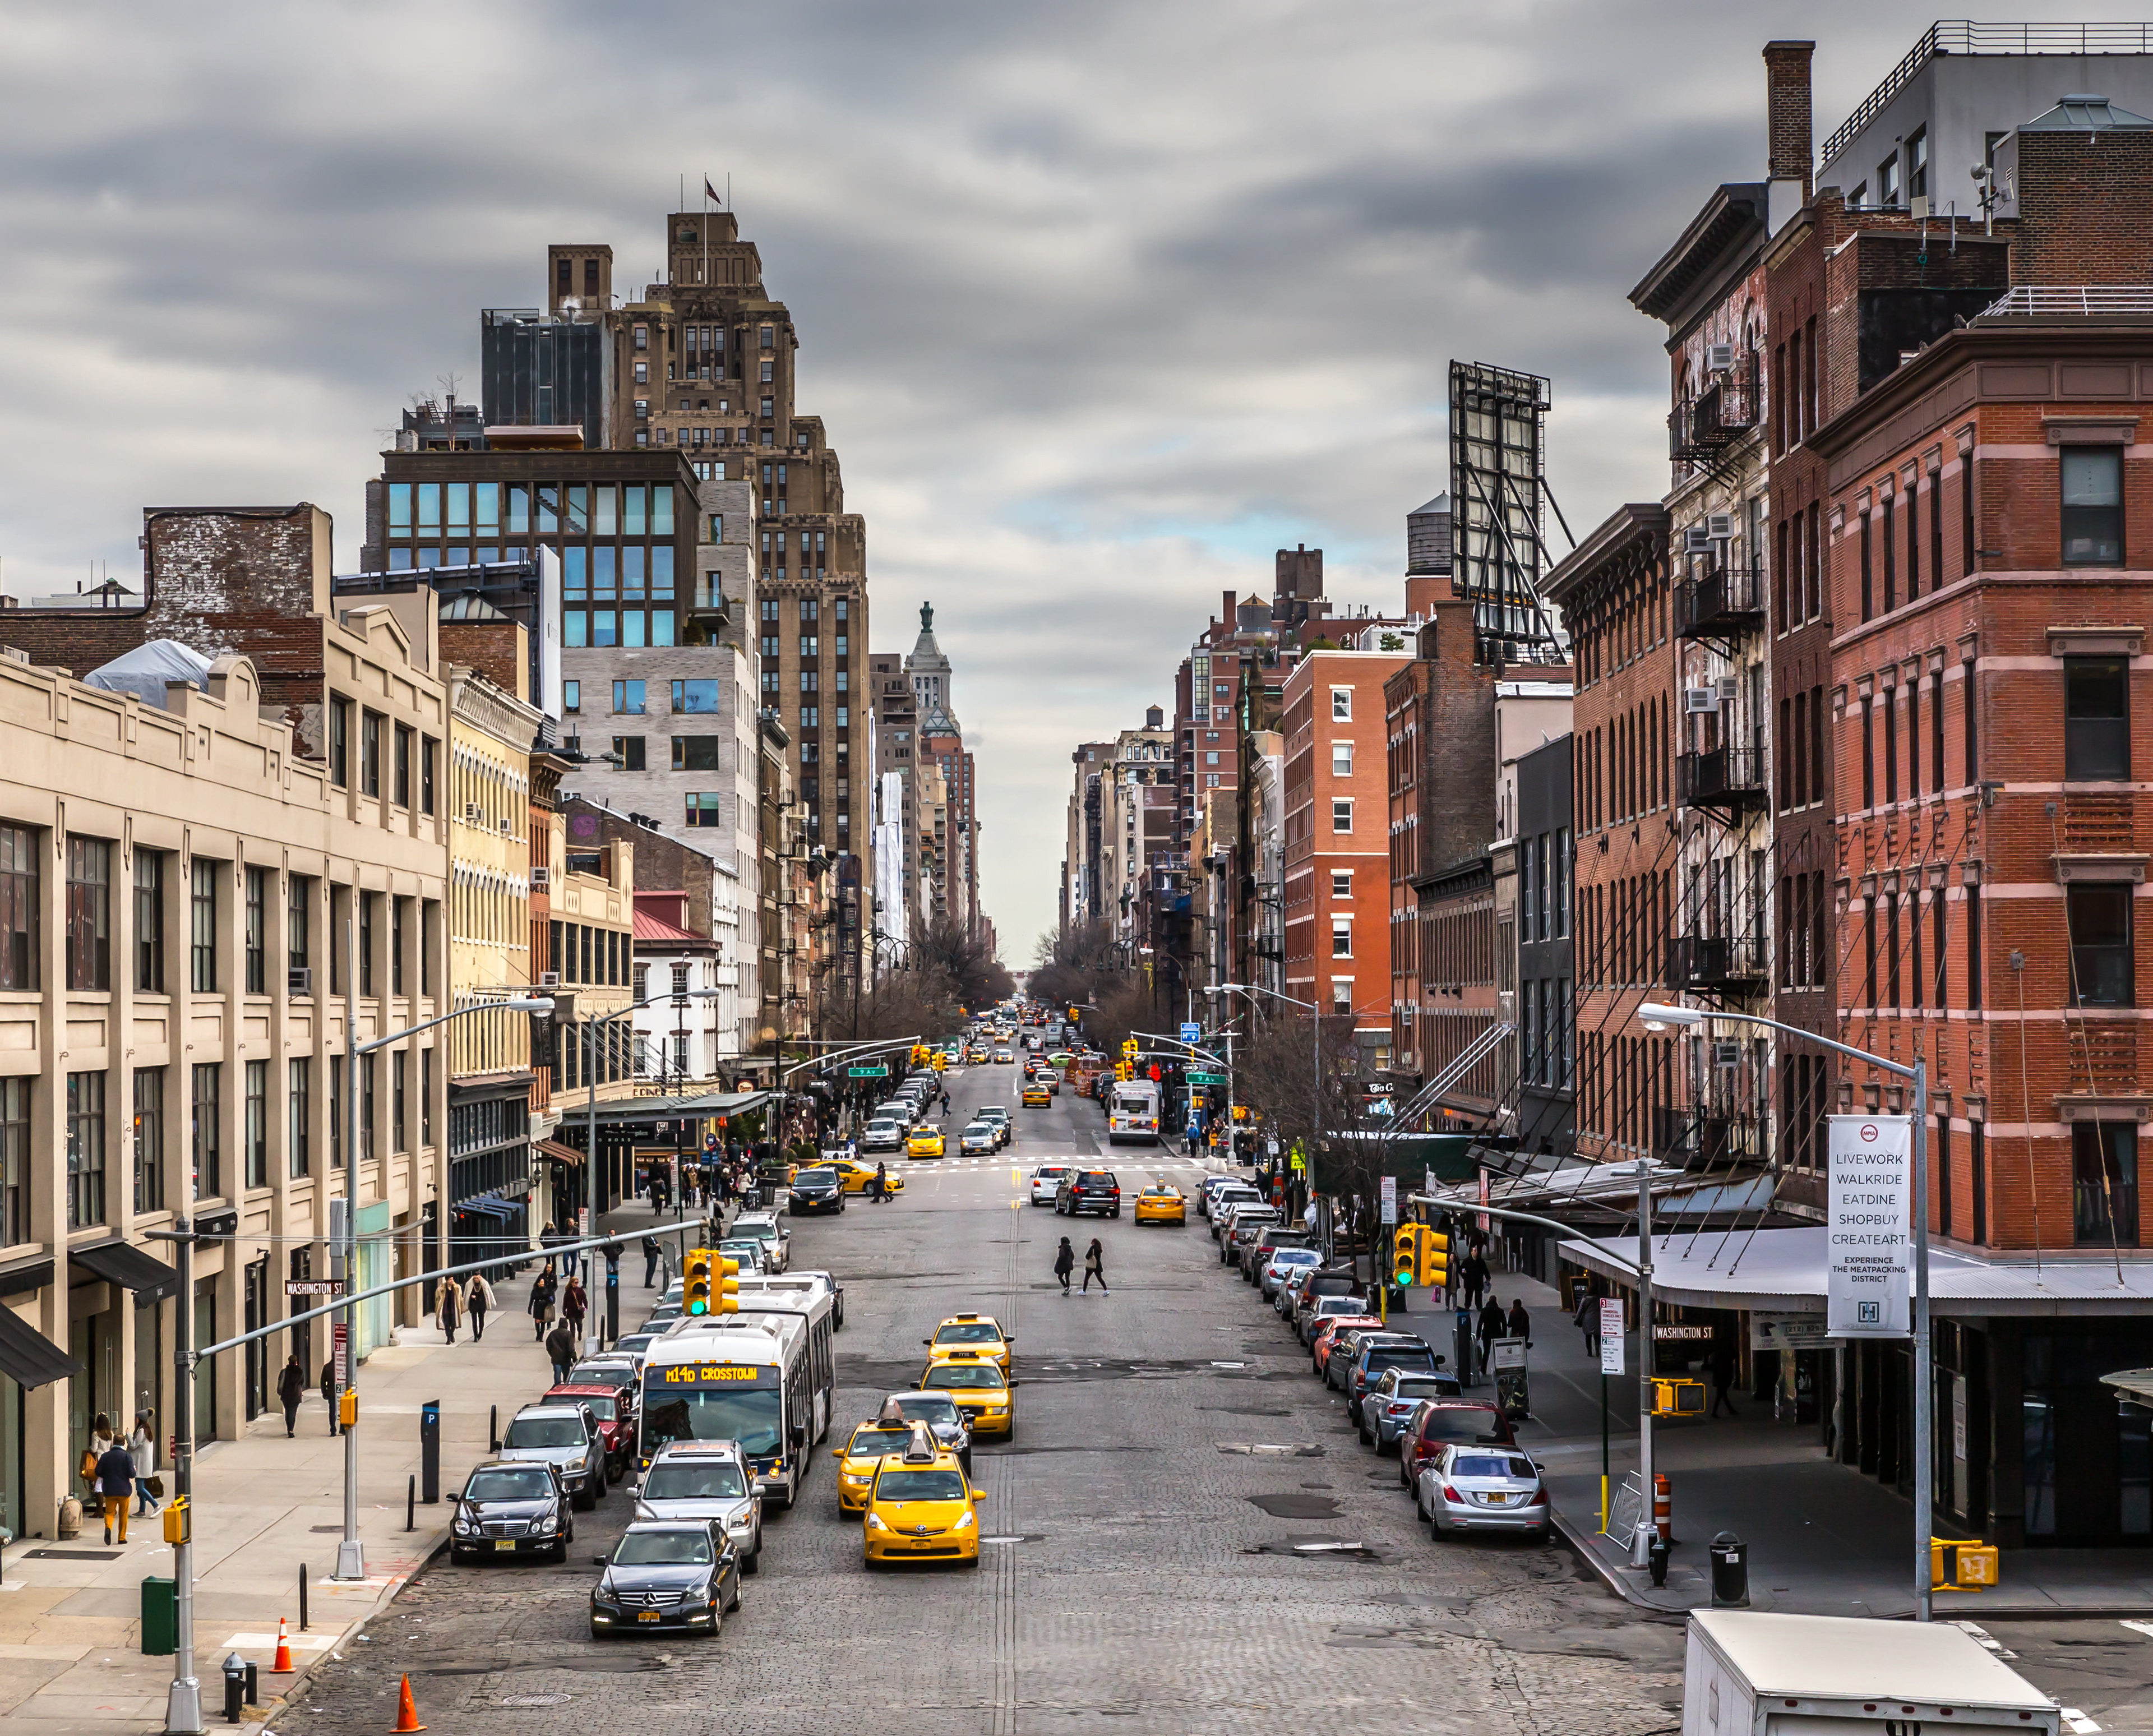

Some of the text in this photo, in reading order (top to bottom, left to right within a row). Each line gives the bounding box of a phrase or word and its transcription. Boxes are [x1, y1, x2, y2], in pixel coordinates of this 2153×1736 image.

[1836, 1154, 1903, 1165] LIVEWORK
[1836, 1174, 1902, 1184] WALKRIDE
[1842, 1194, 1896, 1205] EATDINE
[1839, 1215, 1899, 1225] SHOPBUY
[1832, 1234, 1906, 1245] CREATEART
[287, 1282, 343, 1295] WASHINGTON ST
[1461, 1317, 1466, 1325] P
[1657, 1327, 1712, 1338] WASHINGTON ST
[666, 1366, 757, 1383] M14D CROSSTOWN
